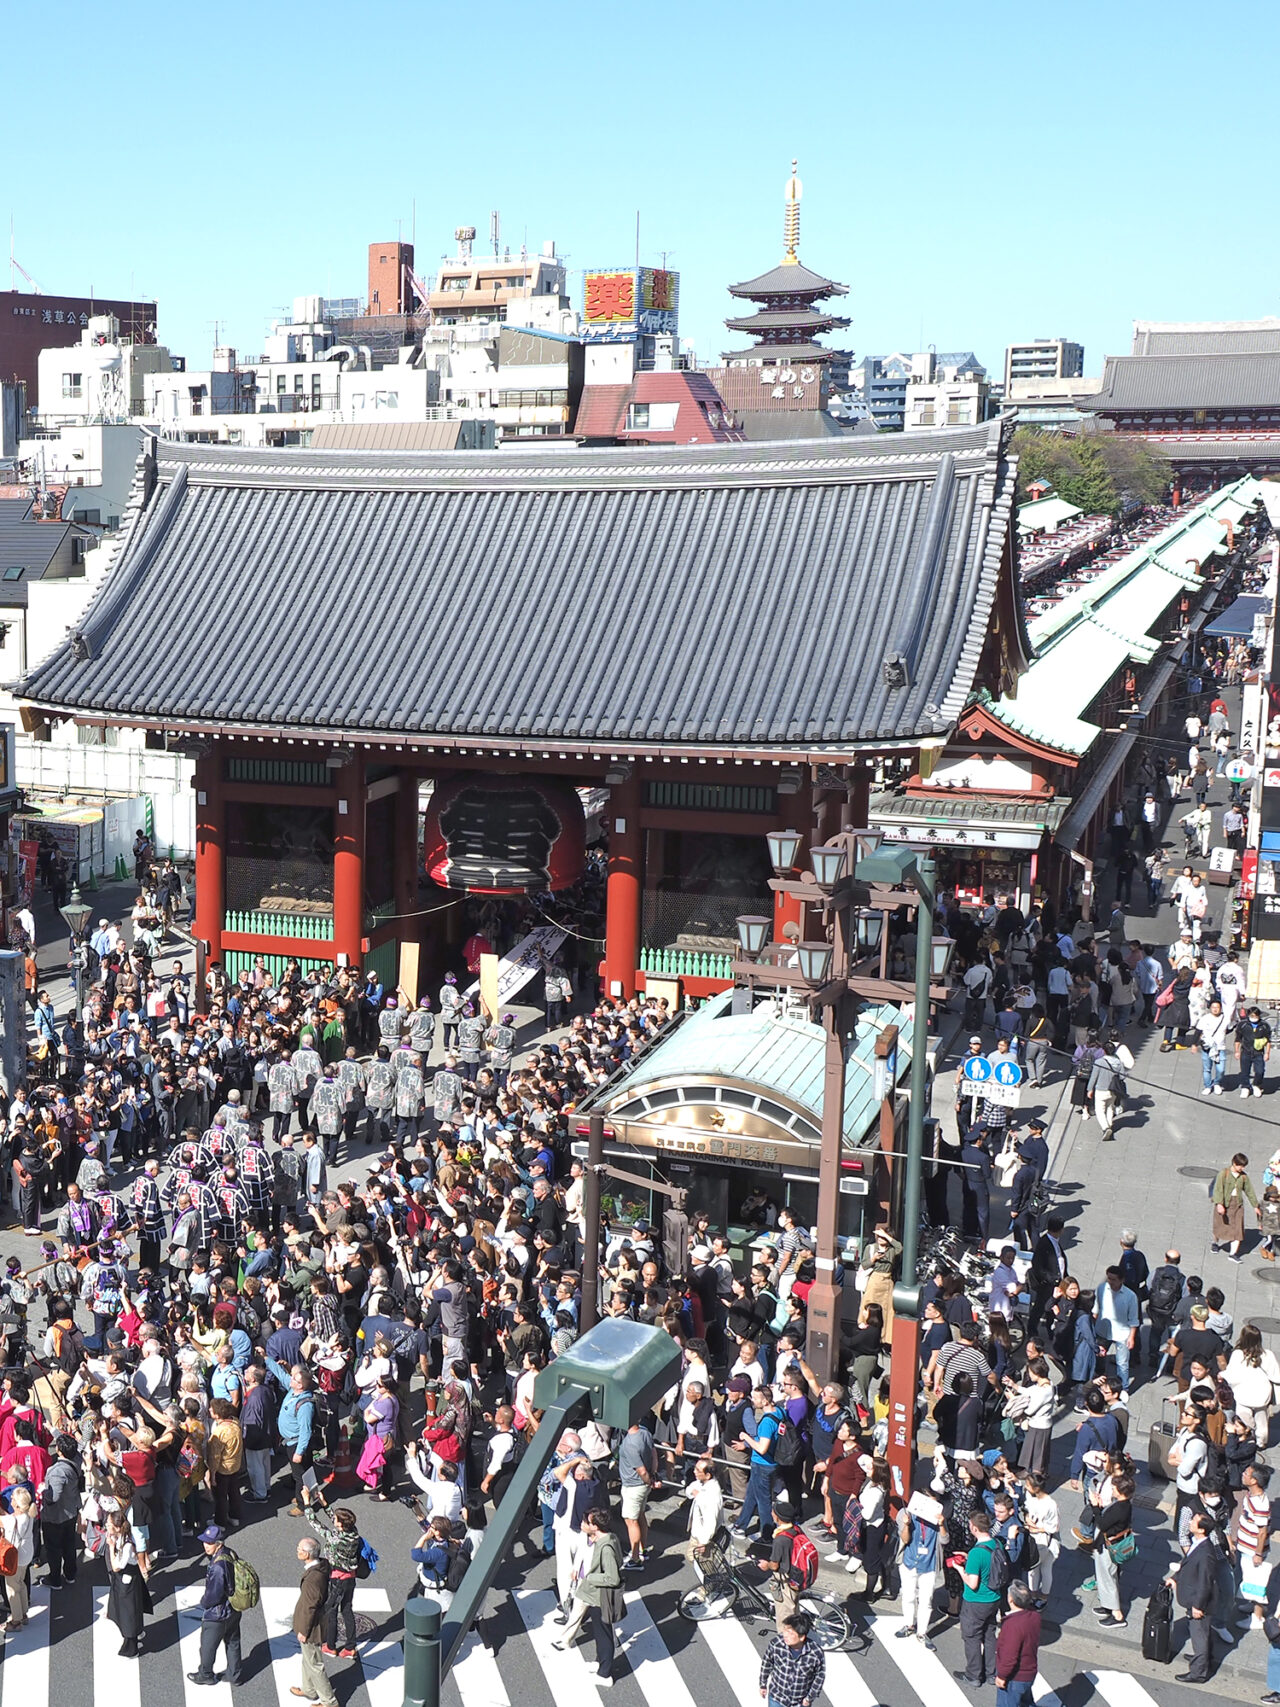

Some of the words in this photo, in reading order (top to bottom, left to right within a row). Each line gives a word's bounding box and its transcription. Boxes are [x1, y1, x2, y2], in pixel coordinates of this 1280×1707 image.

[586, 275, 633, 320] 薬
[1243, 720, 1254, 748] とん久
[917, 835, 955, 843] SHOPPING
[669, 1151, 736, 1165] KAMINARIMON
[741, 1158, 774, 1170] KOBAN
[710, 1139, 778, 1161] 雷門交番
